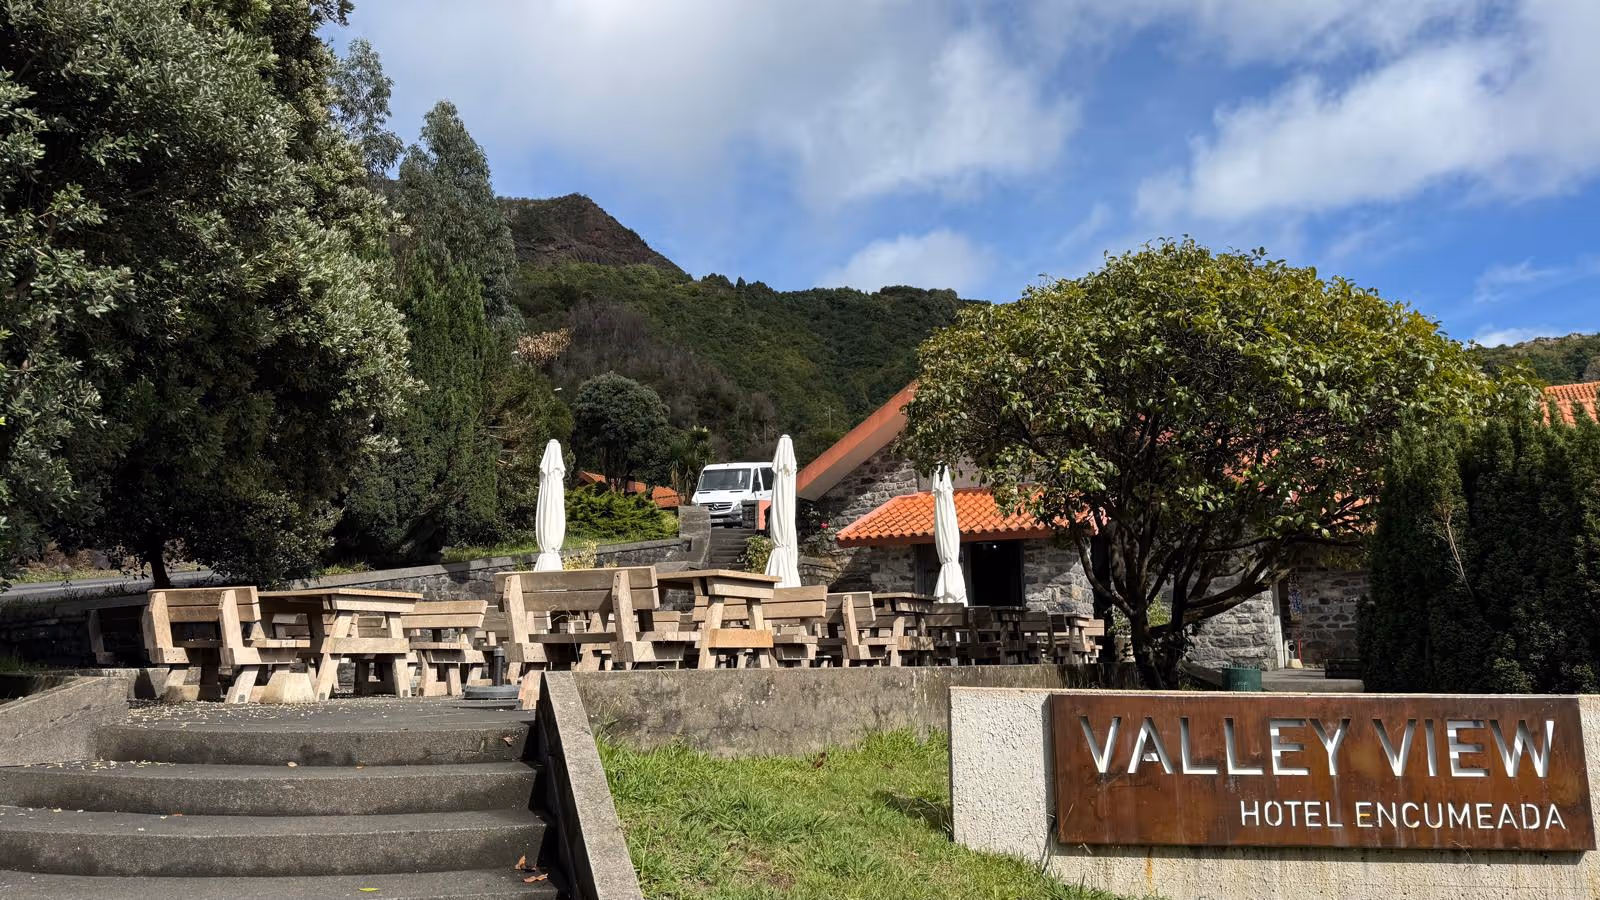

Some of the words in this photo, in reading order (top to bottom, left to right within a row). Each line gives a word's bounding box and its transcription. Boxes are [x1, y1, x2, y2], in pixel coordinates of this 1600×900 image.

[1079, 716, 1352, 776] VALLEY
[1371, 718, 1555, 778] VIEW
[1240, 800, 1343, 828] HOTEL
[1355, 801, 1566, 830] ENCUMEADA
